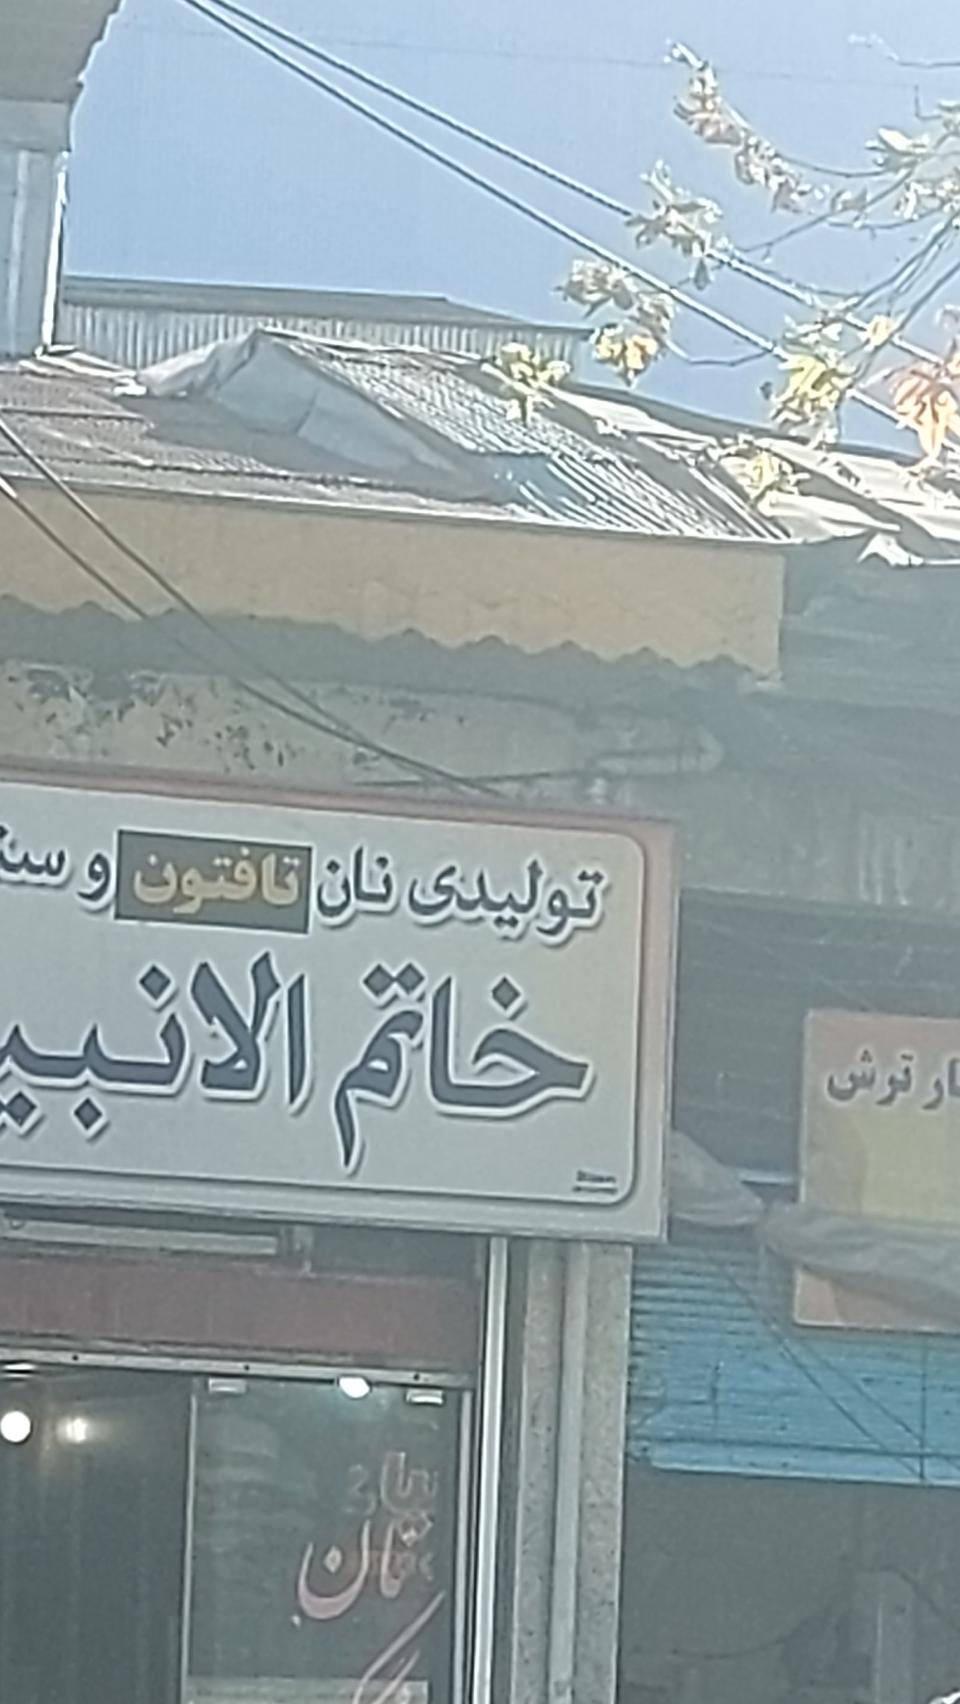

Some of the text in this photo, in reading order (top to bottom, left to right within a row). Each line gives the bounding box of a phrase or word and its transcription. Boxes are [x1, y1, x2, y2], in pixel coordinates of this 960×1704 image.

[77, 852, 112, 902] و
[133, 846, 301, 915] تافتون
[316, 845, 394, 918] نان
[408, 859, 604, 937] تولیدی
[334, 961, 591, 1168] خاتم
[826, 1048, 960, 1111] ار ترش
